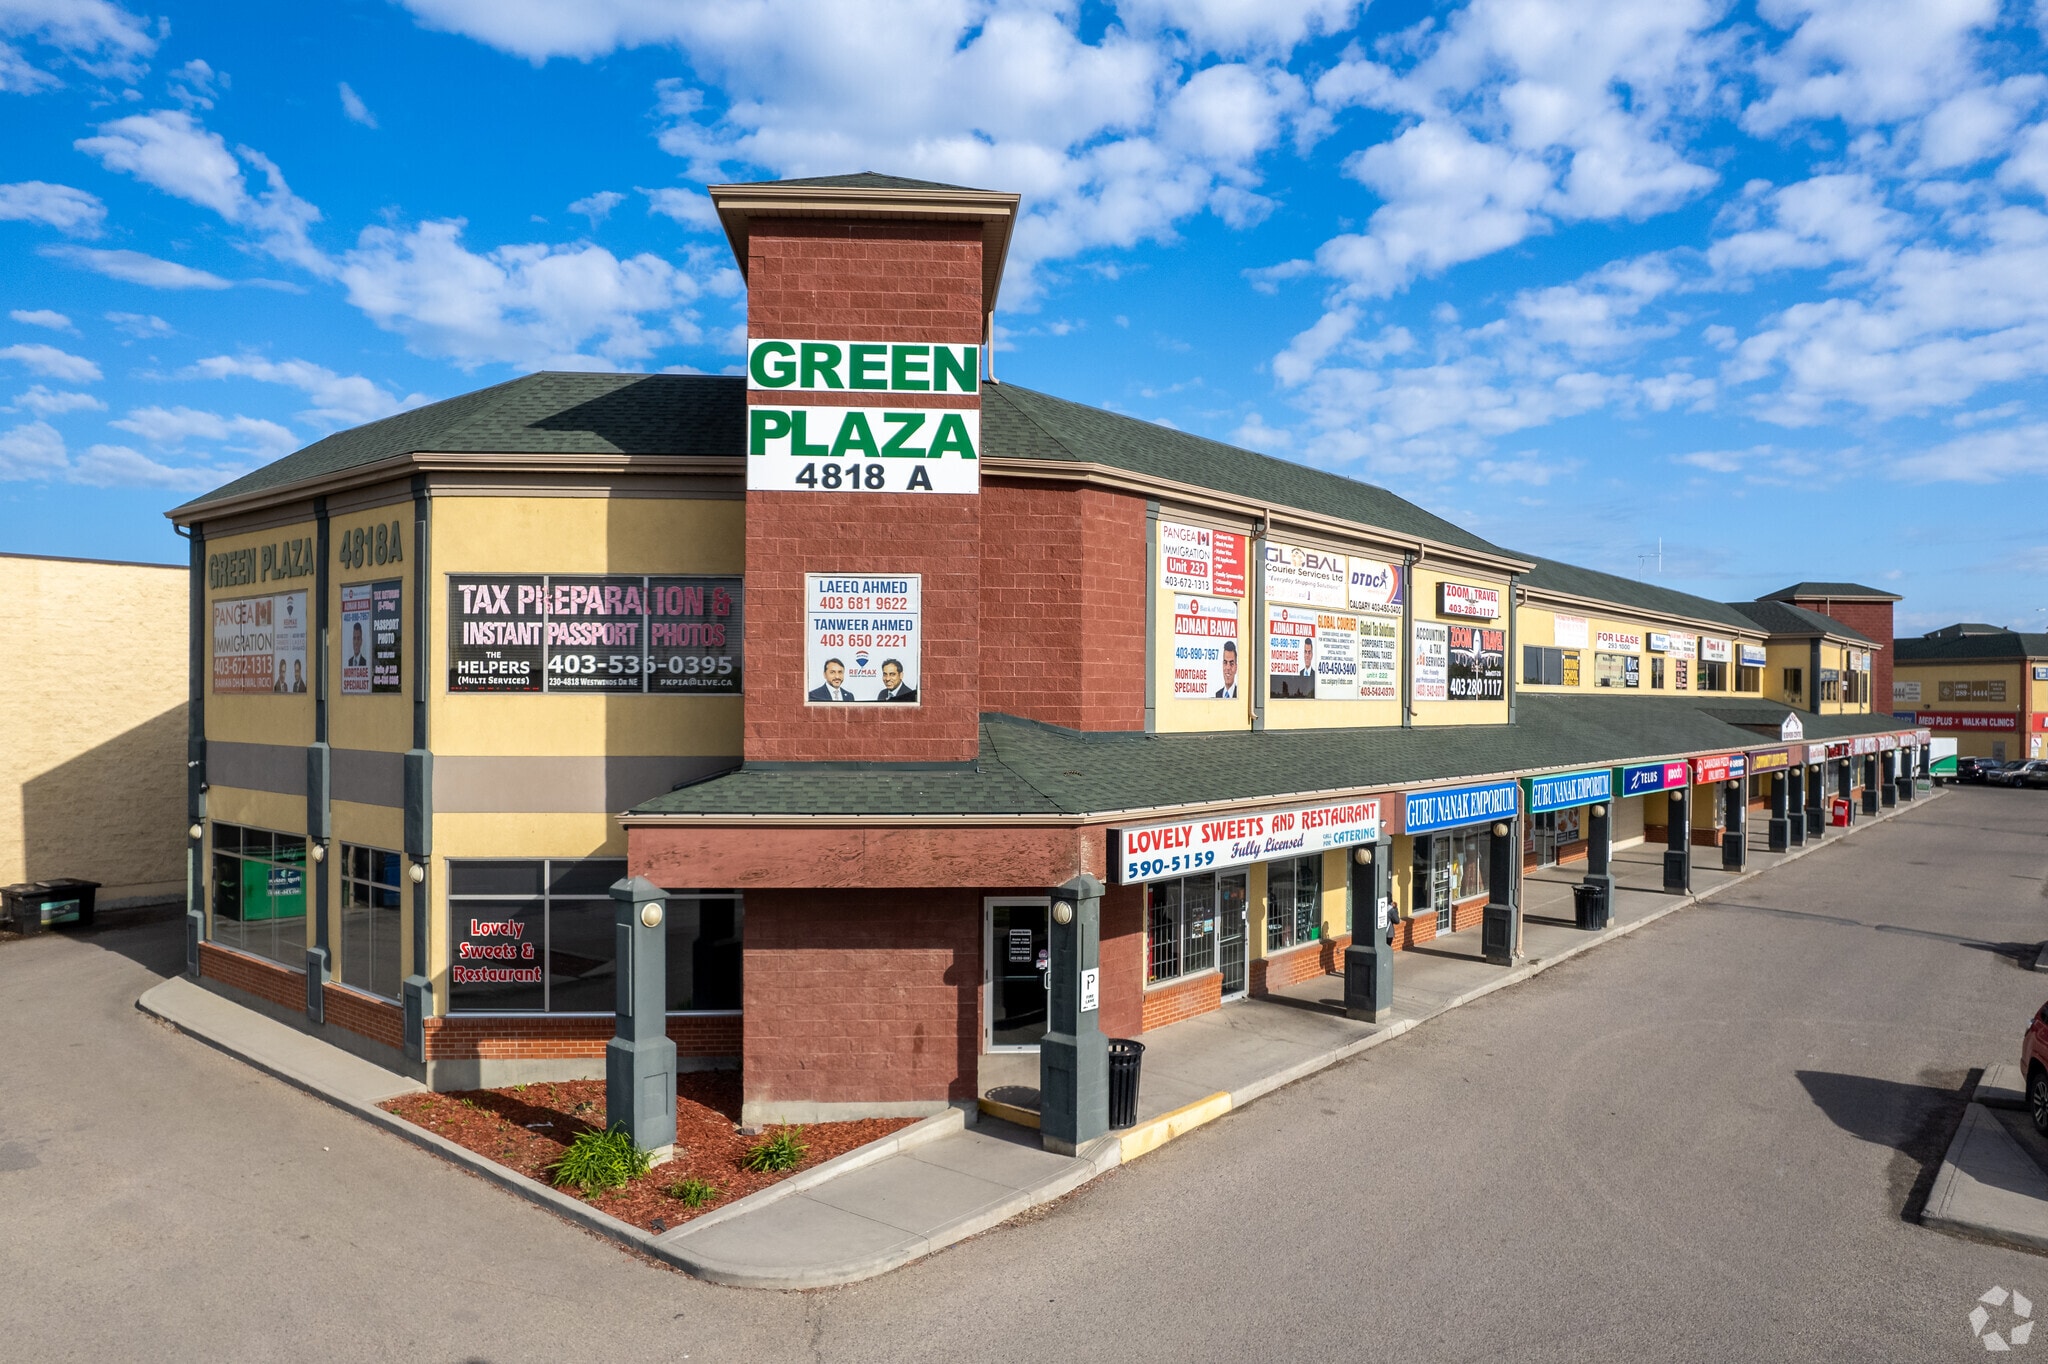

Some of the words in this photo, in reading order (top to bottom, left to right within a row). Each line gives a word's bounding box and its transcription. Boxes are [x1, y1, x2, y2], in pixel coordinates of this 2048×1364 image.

[750, 341, 977, 392] GREEN
[750, 410, 977, 459] PLAZA
[796, 463, 885, 490] 4818
[906, 465, 933, 490] A
[1163, 525, 1196, 542] PANGEA
[340, 520, 403, 570] 4818A
[1163, 544, 1210, 560] IMMIGRATION
[208, 547, 257, 590] GREEN
[261, 537, 314, 582] PLAZA
[1170, 558, 1187, 573] Unit
[1190, 562, 1204, 575] 232
[1265, 547, 1343, 574] GLOBAL
[1265, 563, 1295, 575] Courier
[1297, 568, 1330, 580] Services
[1332, 574, 1343, 582] Ltd
[1351, 572, 1380, 588] DTDC
[819, 581, 859, 594] LAEEQ
[862, 581, 907, 594] AHMED
[1165, 576, 1209, 590] 403-672-1313
[458, 584, 512, 615] TAX
[713, 586, 732, 616] &
[1446, 585, 1469, 599] ZOOM
[1475, 589, 1497, 602] TRAVEL
[820, 597, 843, 610] 403
[848, 597, 869, 610] 681
[876, 597, 907, 610] 9622
[1350, 600, 1370, 610] CALGARY
[1449, 604, 1494, 617] 403-280-1117
[214, 604, 254, 627] PANGEA
[1317, 614, 1336, 629] GLOBAL
[1337, 617, 1356, 631] COURIER
[373, 618, 399, 631] PASSPORT
[814, 619, 868, 631] TANWEER
[872, 619, 913, 631] AHMED
[1175, 616, 1209, 635] ADNAN
[1210, 619, 1236, 637] BAWA
[1273, 622, 1294, 635] ADNAN
[1295, 624, 1312, 637] BAWA
[377, 633, 395, 645] PHOTO
[463, 621, 542, 646] INSTANT
[547, 621, 639, 646] PASSPORT
[651, 622, 725, 647] PHOTOS
[820, 634, 843, 647] 403
[848, 634, 871, 647] 650
[876, 635, 906, 647] 2221
[1416, 627, 1445, 642] ACCOUNTING
[1450, 626, 1472, 649] ZOOM
[1482, 631, 1503, 651] TRAVEL
[1597, 632, 1613, 642] FOR
[1615, 634, 1639, 645] LEASE
[214, 633, 272, 653] IMMIGRATION
[1362, 639, 1383, 648] CORPORATE
[1433, 644, 1441, 654] TAX
[1175, 647, 1219, 660] 403-890-7957
[1271, 650, 1298, 661] MORTGAGE
[1362, 650, 1380, 659] PERSONAL
[1425, 656, 1445, 667] SERVICES
[214, 656, 273, 675] 403-672-1313
[457, 660, 530, 674] HELPERS
[548, 655, 733, 675] 403-536-0395
[1271, 662, 1299, 673] SPECIALIST
[1318, 662, 1356, 675] 403-450-3400
[549, 677, 579, 686] 230-4818
[629, 677, 638, 686] NE
[1175, 669, 1206, 680] MORTGAGE
[344, 680, 369, 690] SPECIALIST
[1175, 682, 1207, 693] SPECIALIST
[1450, 678, 1464, 696] 403
[1466, 679, 1482, 695] 280
[1484, 679, 1501, 696] 1117
[1919, 716, 1935, 725] MEDI
[1936, 716, 1952, 726] PLUS
[1962, 717, 1988, 726] WALK-IN
[1989, 718, 2014, 727] CLINICS
[1704, 757, 1720, 769] CANADIAN
[1641, 771, 1657, 784] TELUS
[1532, 784, 1554, 808] GURU
[1554, 780, 1577, 804] NANAK
[1577, 774, 1609, 800] EMPORIUM
[1407, 799, 1436, 827] GURU
[1437, 793, 1470, 823] NANAK
[1470, 786, 1515, 816] EMPORIUM
[1128, 826, 1192, 855] LOVELY
[1201, 817, 1263, 843] SWEETS
[1272, 813, 1295, 834] AND
[1302, 803, 1376, 830] RESTAURANT
[1128, 851, 1215, 879] 590-5159
[1230, 841, 1261, 859] Fully
[1263, 834, 1304, 853] Licensed
[1333, 827, 1375, 844] CATERING
[471, 918, 524, 940] Lovely
[459, 942, 517, 959] Sweets
[521, 942, 535, 960] &
[453, 965, 542, 984] Restaurant
